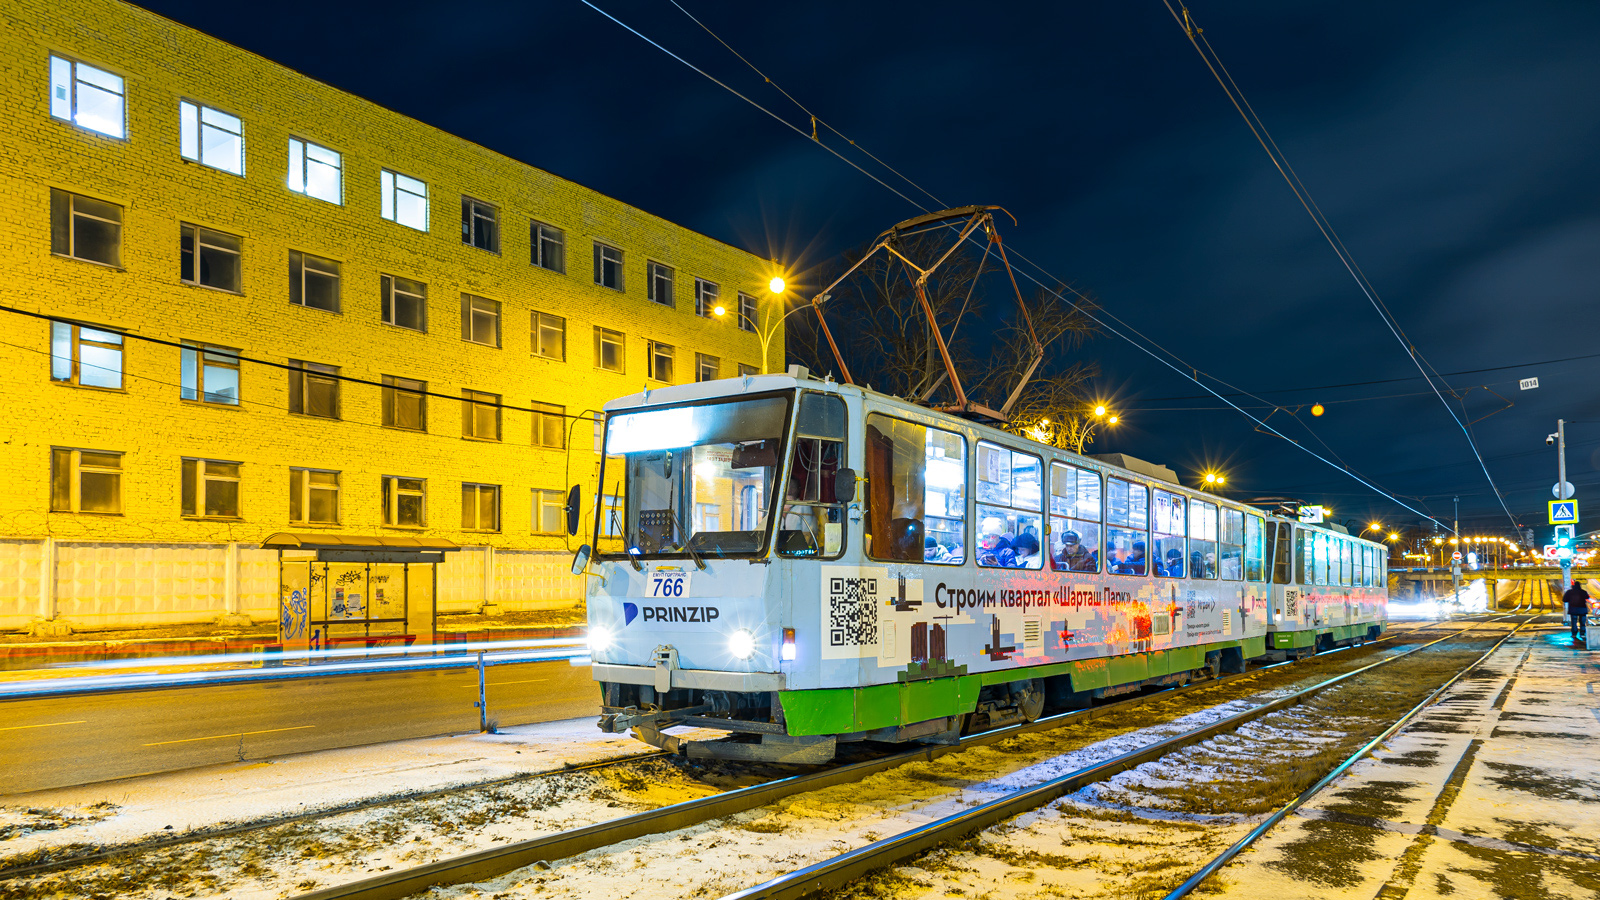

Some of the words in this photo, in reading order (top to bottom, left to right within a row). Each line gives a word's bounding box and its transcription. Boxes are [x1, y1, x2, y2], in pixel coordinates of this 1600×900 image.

[1520, 380, 1537, 388] 1014
[653, 578, 684, 596] 766
[935, 582, 996, 616] Строим
[1000, 588, 1050, 614] квартал
[1053, 585, 1101, 612] «Шарташ
[1103, 586, 1132, 611] Парк»
[642, 606, 720, 623] PRINZIP
